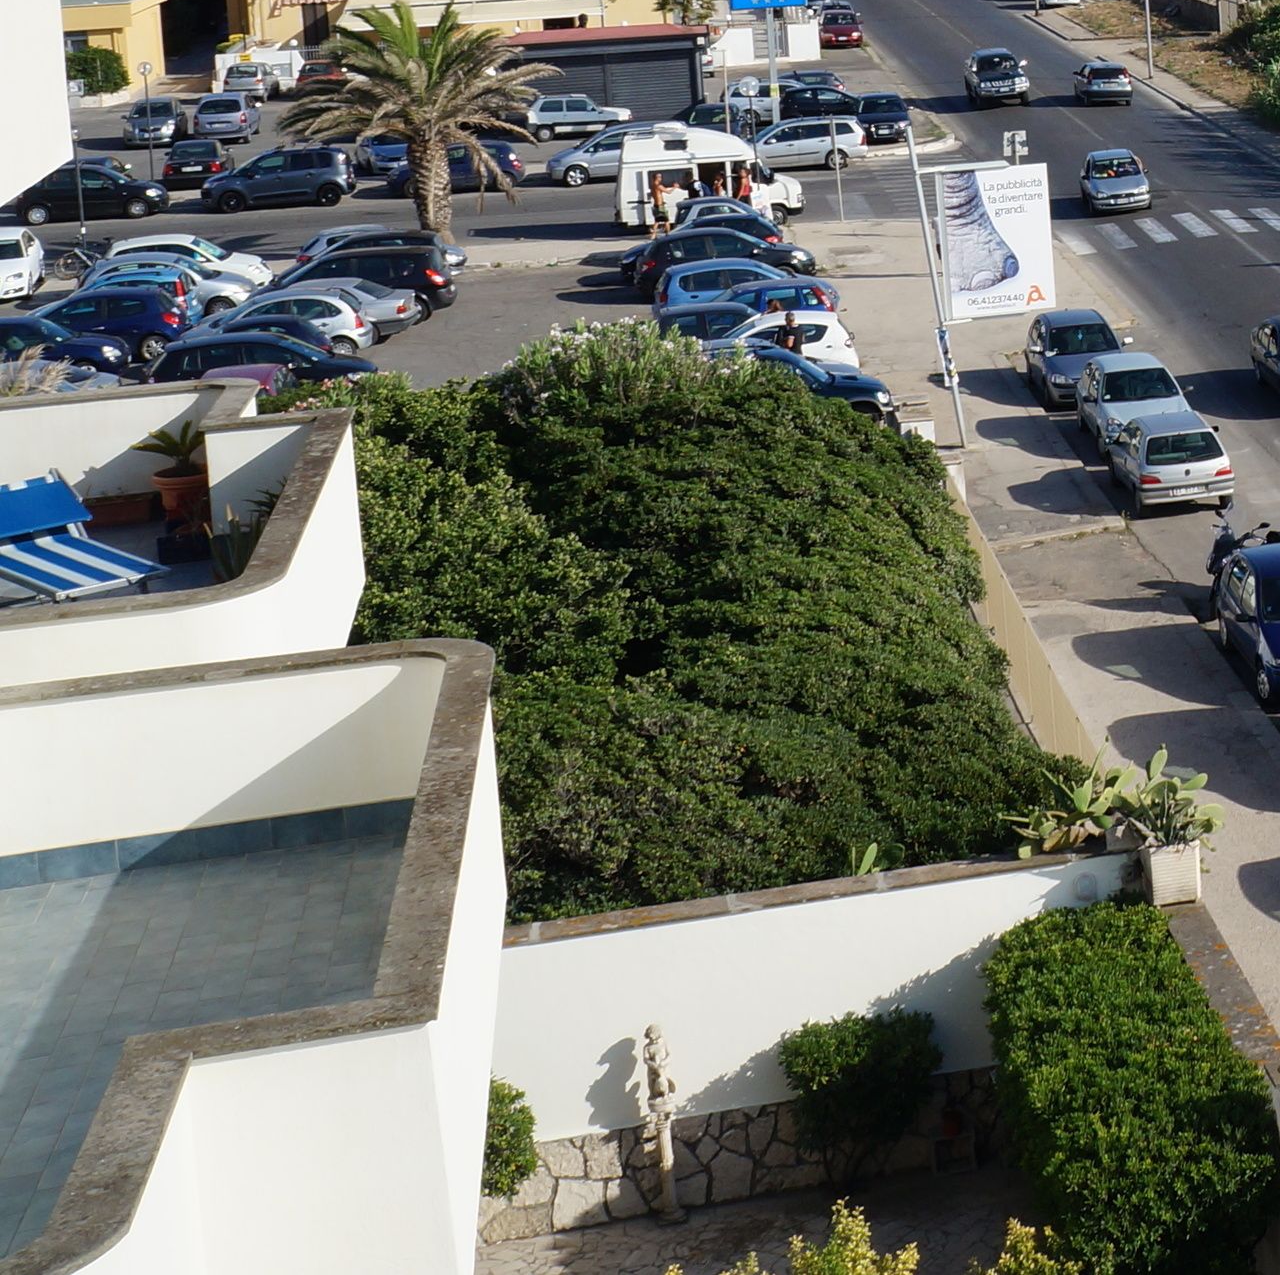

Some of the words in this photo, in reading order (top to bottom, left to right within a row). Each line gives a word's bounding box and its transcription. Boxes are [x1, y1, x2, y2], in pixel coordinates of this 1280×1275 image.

[984, 182, 995, 191] La
[996, 178, 1042, 191] pubblicità
[987, 195, 997, 204] fa
[998, 192, 1043, 203] diventare
